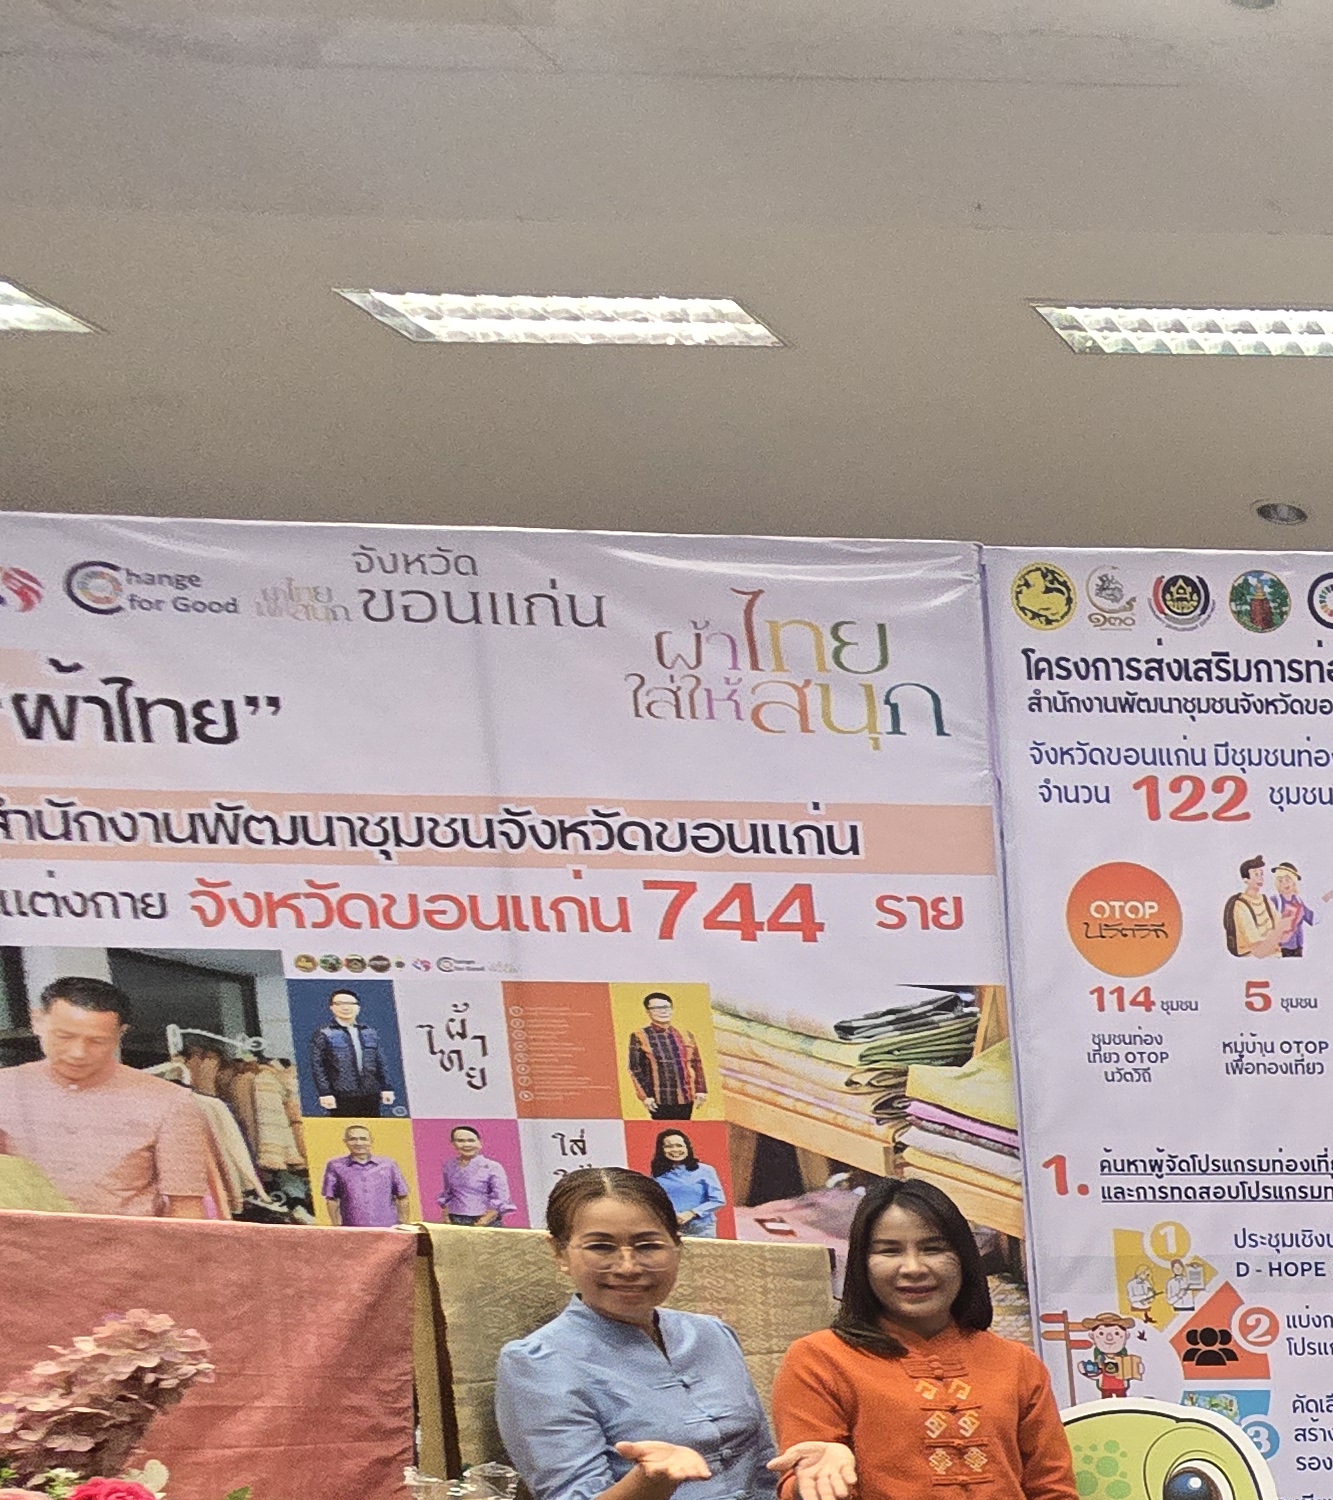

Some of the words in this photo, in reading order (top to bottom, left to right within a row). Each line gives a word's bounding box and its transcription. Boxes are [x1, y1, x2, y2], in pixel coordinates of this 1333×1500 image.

[352, 546, 478, 578] จังหวัด
[128, 594, 166, 614] for
[173, 594, 239, 615] Good
[358, 578, 607, 628] ขอนแก่น
[655, 588, 889, 674] ผ้าไทย
[625, 673, 952, 751] ใส่ให้สนุก
[1029, 735, 1207, 768] จังหวัดขอนแก่น
[1038, 778, 1111, 805] จำนวน
[1132, 774, 1251, 823] 122
[190, 868, 630, 935] จังหวัดขอนแก่น
[642, 880, 825, 943] 744
[873, 889, 964, 932] ราย
[1088, 900, 1159, 920] OTOP
[1089, 985, 1156, 1013] 114
[1160, 999, 1199, 1016] ชุมชน
[1244, 980, 1273, 1013] 5
[1280, 996, 1319, 1014] ชุมชน
[1091, 1026, 1164, 1051] ชุมชนท่อง
[1279, 1040, 1329, 1055] OTOP
[1125, 1052, 1170, 1064] OTOP
[1041, 1153, 1090, 1197] 1.
[1159, 1224, 1177, 1252] 1
[1236, 1263, 1250, 1278] D
[1268, 1262, 1327, 1278] HOPE
[1246, 1315, 1273, 1342] 2
[1251, 1428, 1270, 1453] 3
